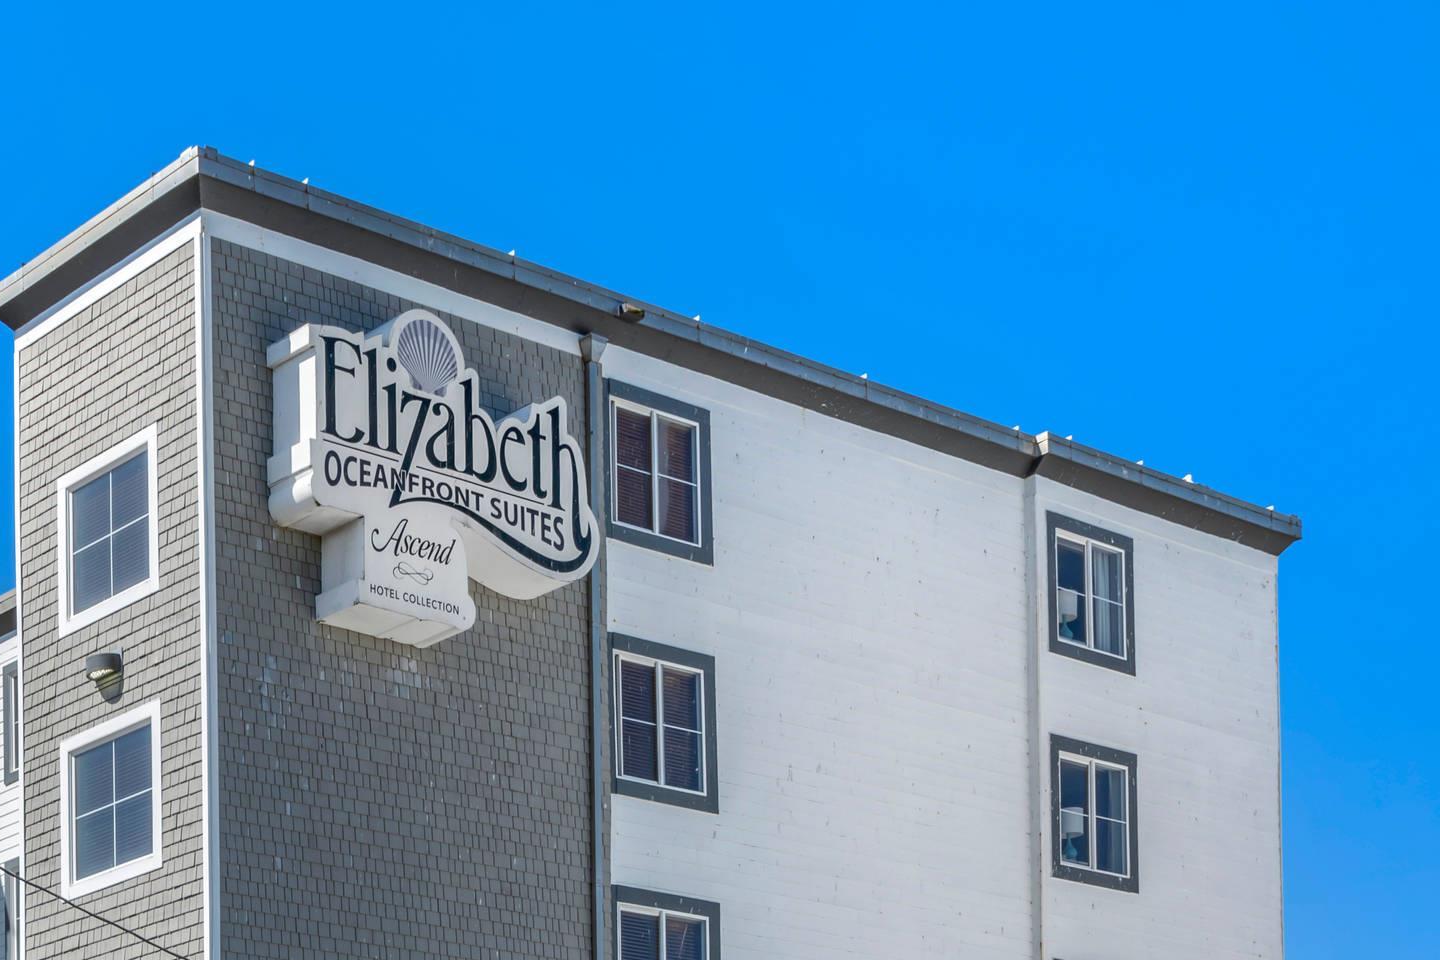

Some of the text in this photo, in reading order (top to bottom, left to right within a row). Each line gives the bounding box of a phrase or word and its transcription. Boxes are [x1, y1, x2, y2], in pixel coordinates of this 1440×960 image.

[319, 335, 588, 553] Elizabeth
[324, 450, 565, 552] OCEANFRONT SUITES
[370, 518, 457, 566] Ascend
[369, 583, 460, 616] HOTEL COLLECTION
